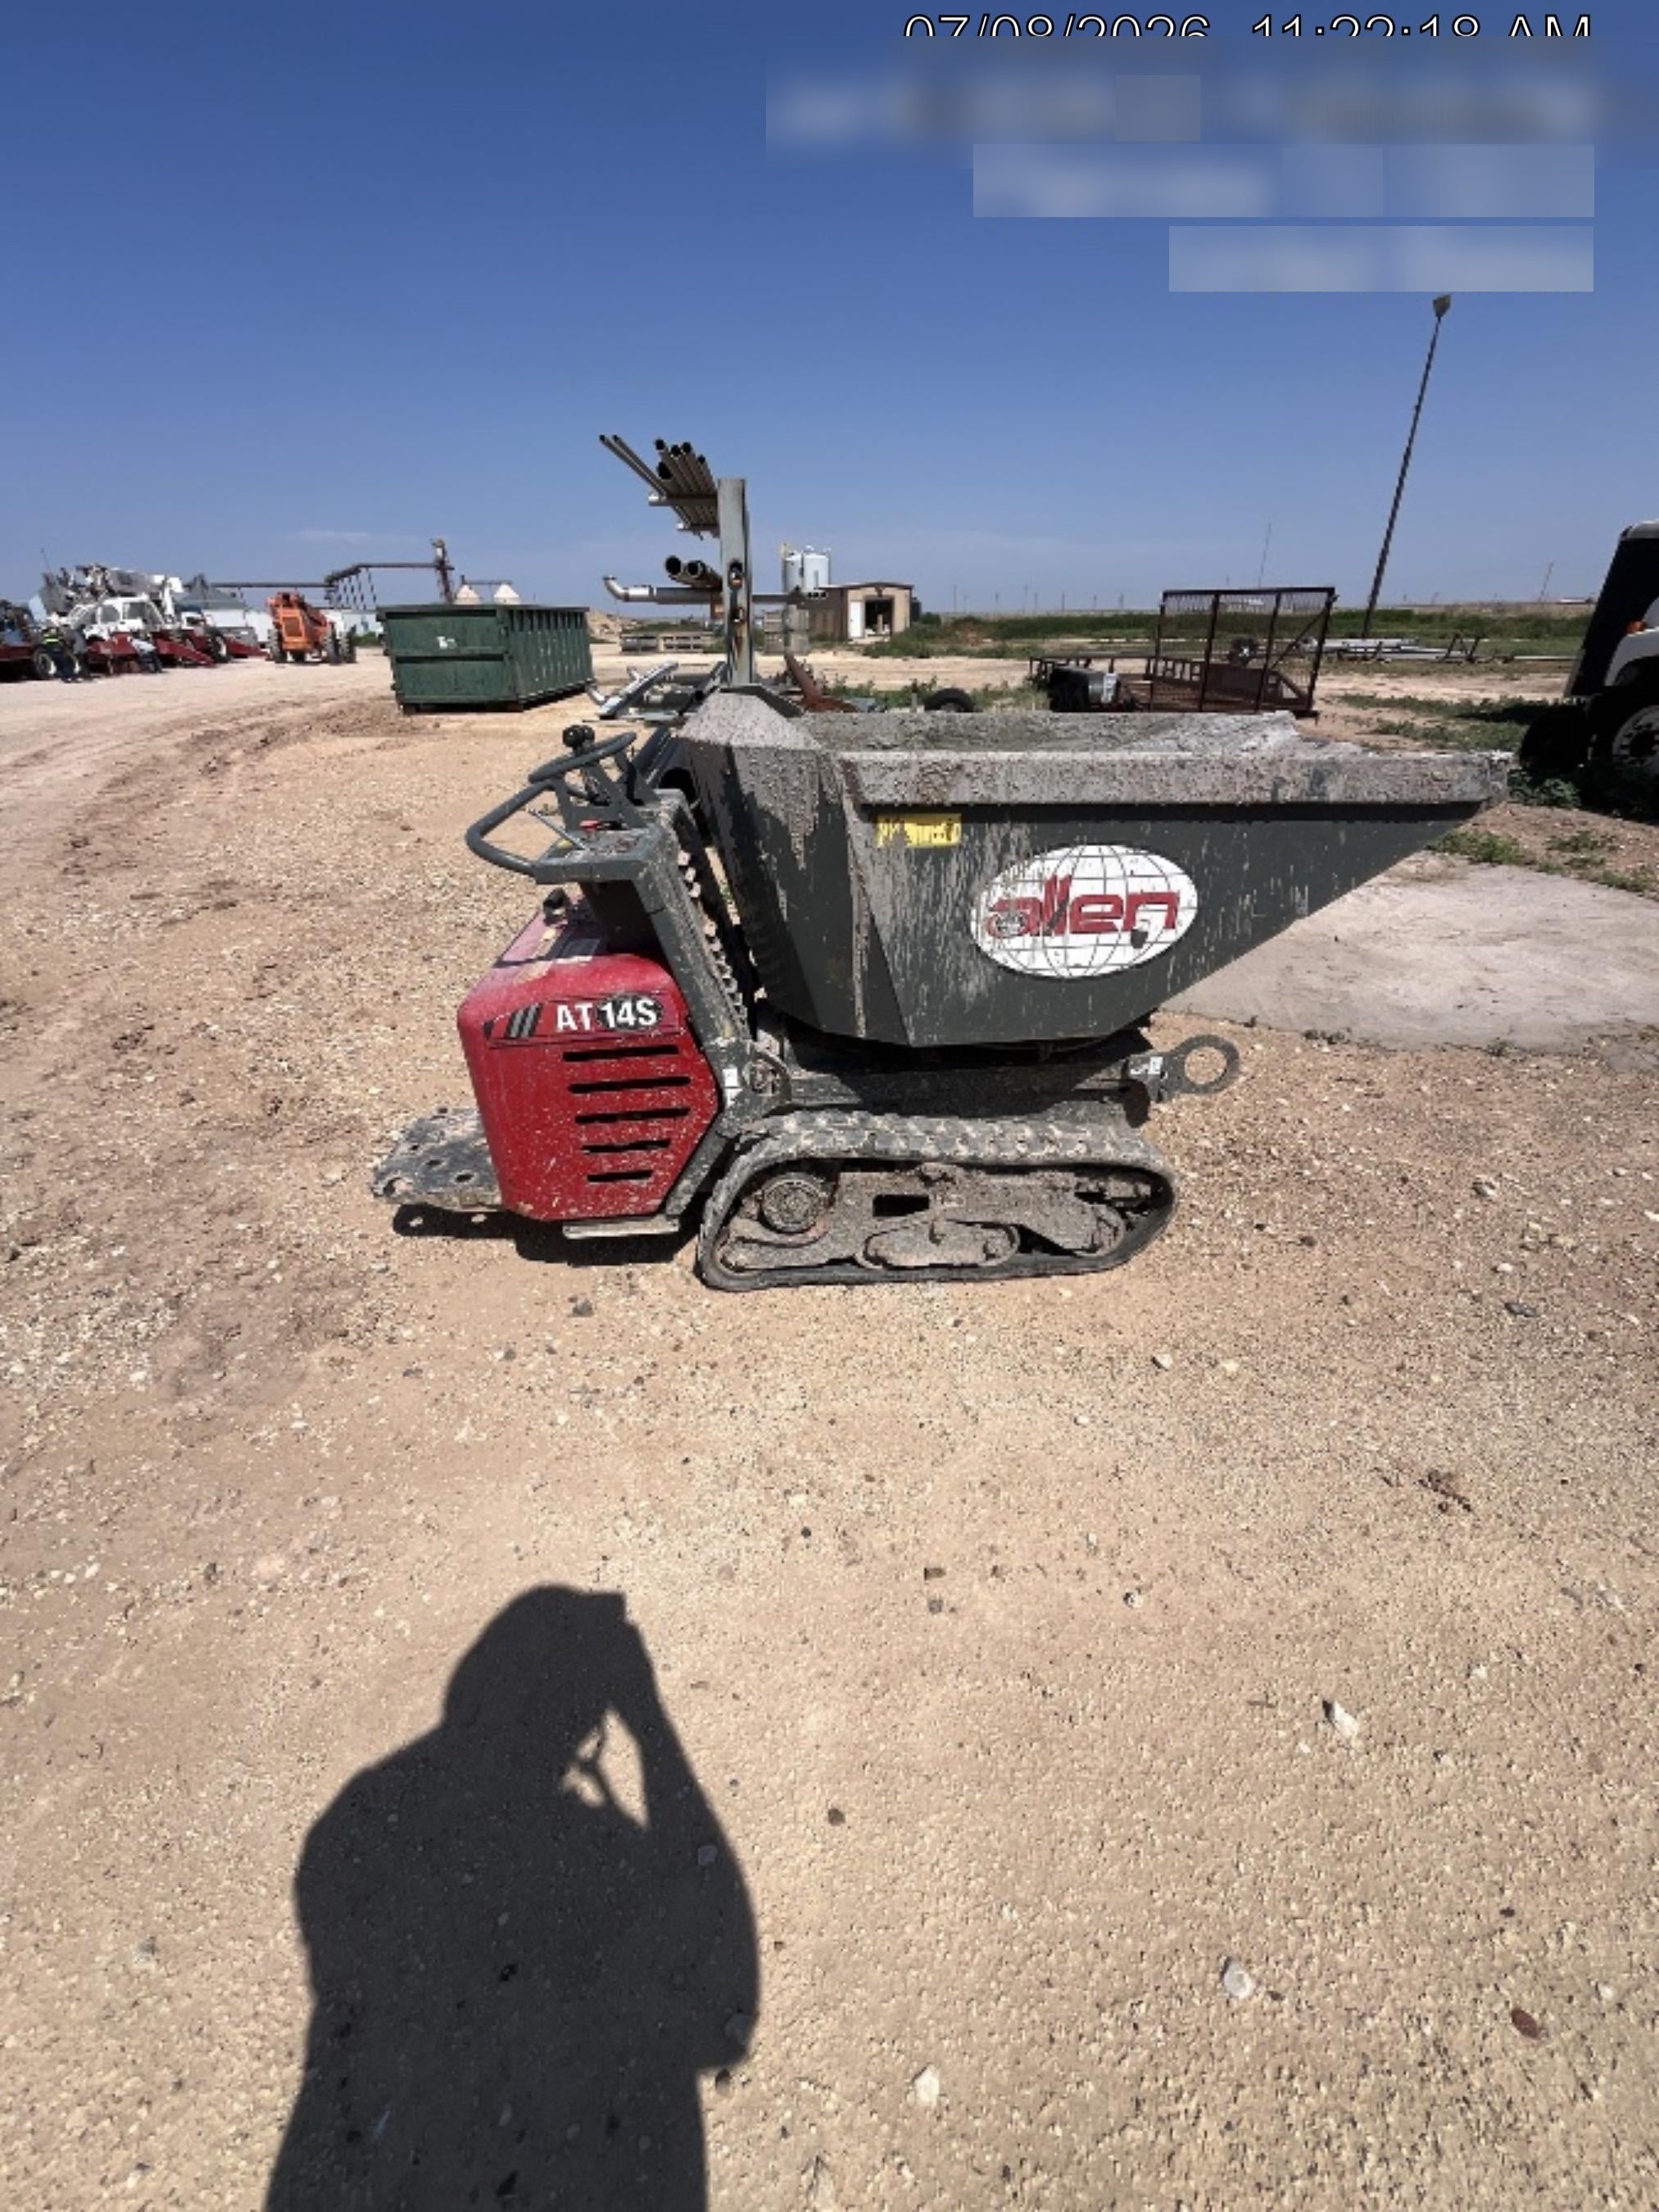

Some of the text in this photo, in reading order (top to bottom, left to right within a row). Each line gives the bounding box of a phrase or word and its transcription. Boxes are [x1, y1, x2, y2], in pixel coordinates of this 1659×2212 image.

[985, 873, 1180, 940] allen
[555, 996, 657, 1032] AT 14S
